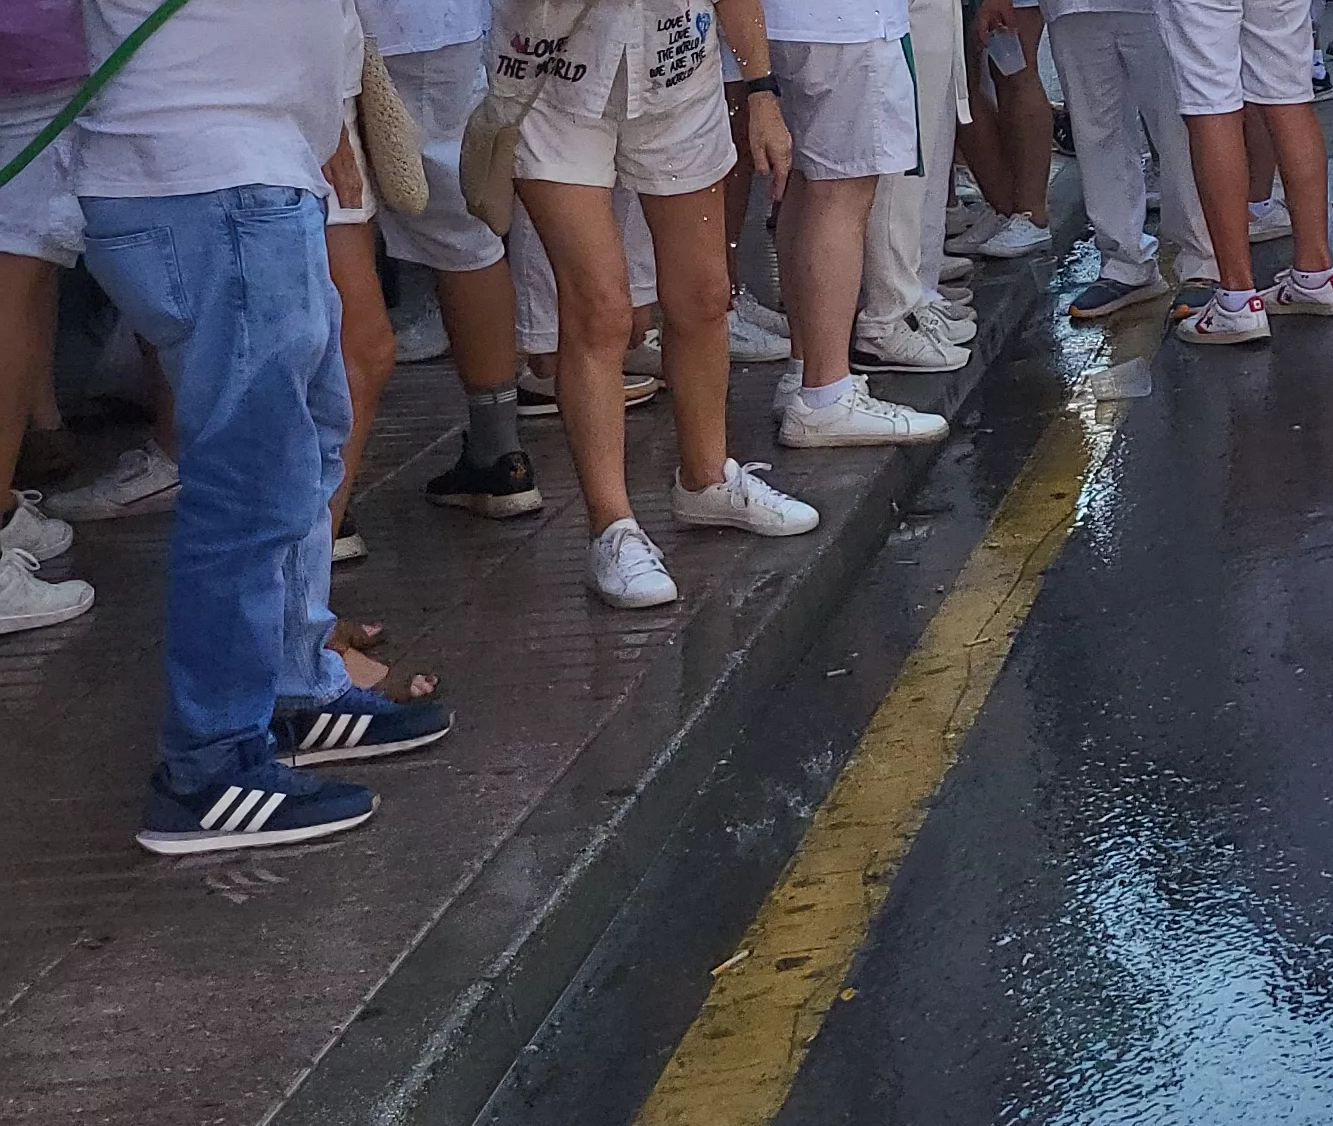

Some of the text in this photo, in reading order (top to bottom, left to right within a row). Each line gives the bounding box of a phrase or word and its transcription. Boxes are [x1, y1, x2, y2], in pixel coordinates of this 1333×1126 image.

[657, 15, 684, 31] LOVE
[669, 27, 691, 45] LOVE
[657, 37, 699, 63] THE WORLD
[496, 55, 529, 79] THE
[670, 56, 687, 73] ARE
